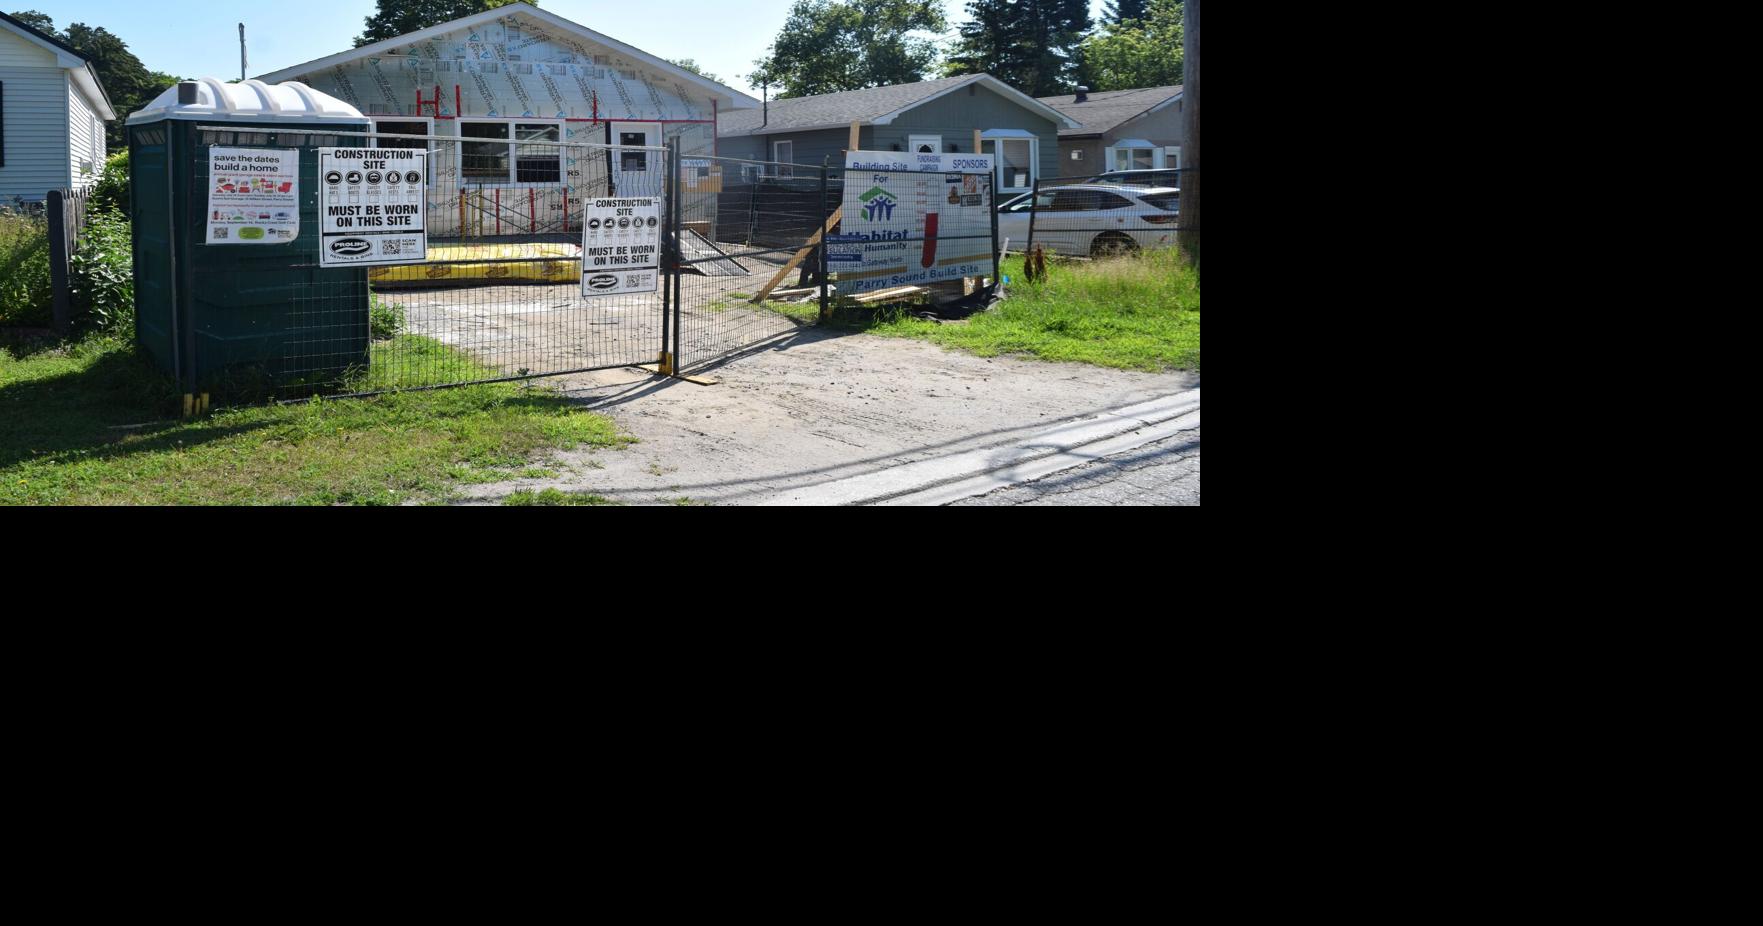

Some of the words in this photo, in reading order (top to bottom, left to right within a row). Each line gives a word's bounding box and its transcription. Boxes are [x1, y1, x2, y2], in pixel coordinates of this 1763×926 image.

[238, 154, 253, 163] the
[254, 155, 280, 163] dates
[334, 149, 413, 160] CONSTRUCTION
[214, 162, 240, 171] build
[249, 164, 278, 172] home
[363, 160, 386, 170] SITE
[892, 162, 908, 171] Site
[952, 159, 988, 169] SPONSORS
[873, 174, 888, 183] For
[595, 199, 652, 208] CONSTRUCTION
[328, 205, 361, 216] MUST
[366, 205, 380, 215] BE
[384, 204, 418, 215] WORN
[616, 208, 633, 216] SITE
[336, 217, 352, 227] ON
[357, 216, 382, 226] THIS
[387, 215, 411, 226] SITE
[588, 246, 613, 257] MUST
[616, 246, 628, 255] BE
[630, 245, 655, 254] WORN
[864, 242, 907, 252] Humanity
[594, 257, 606, 266] ON
[609, 255, 629, 264] THIS
[631, 254, 649, 264] SITE
[856, 279, 887, 290] Parry
[891, 271, 926, 285] Sound
[930, 267, 957, 278] Build
[960, 264, 979, 274] Site
